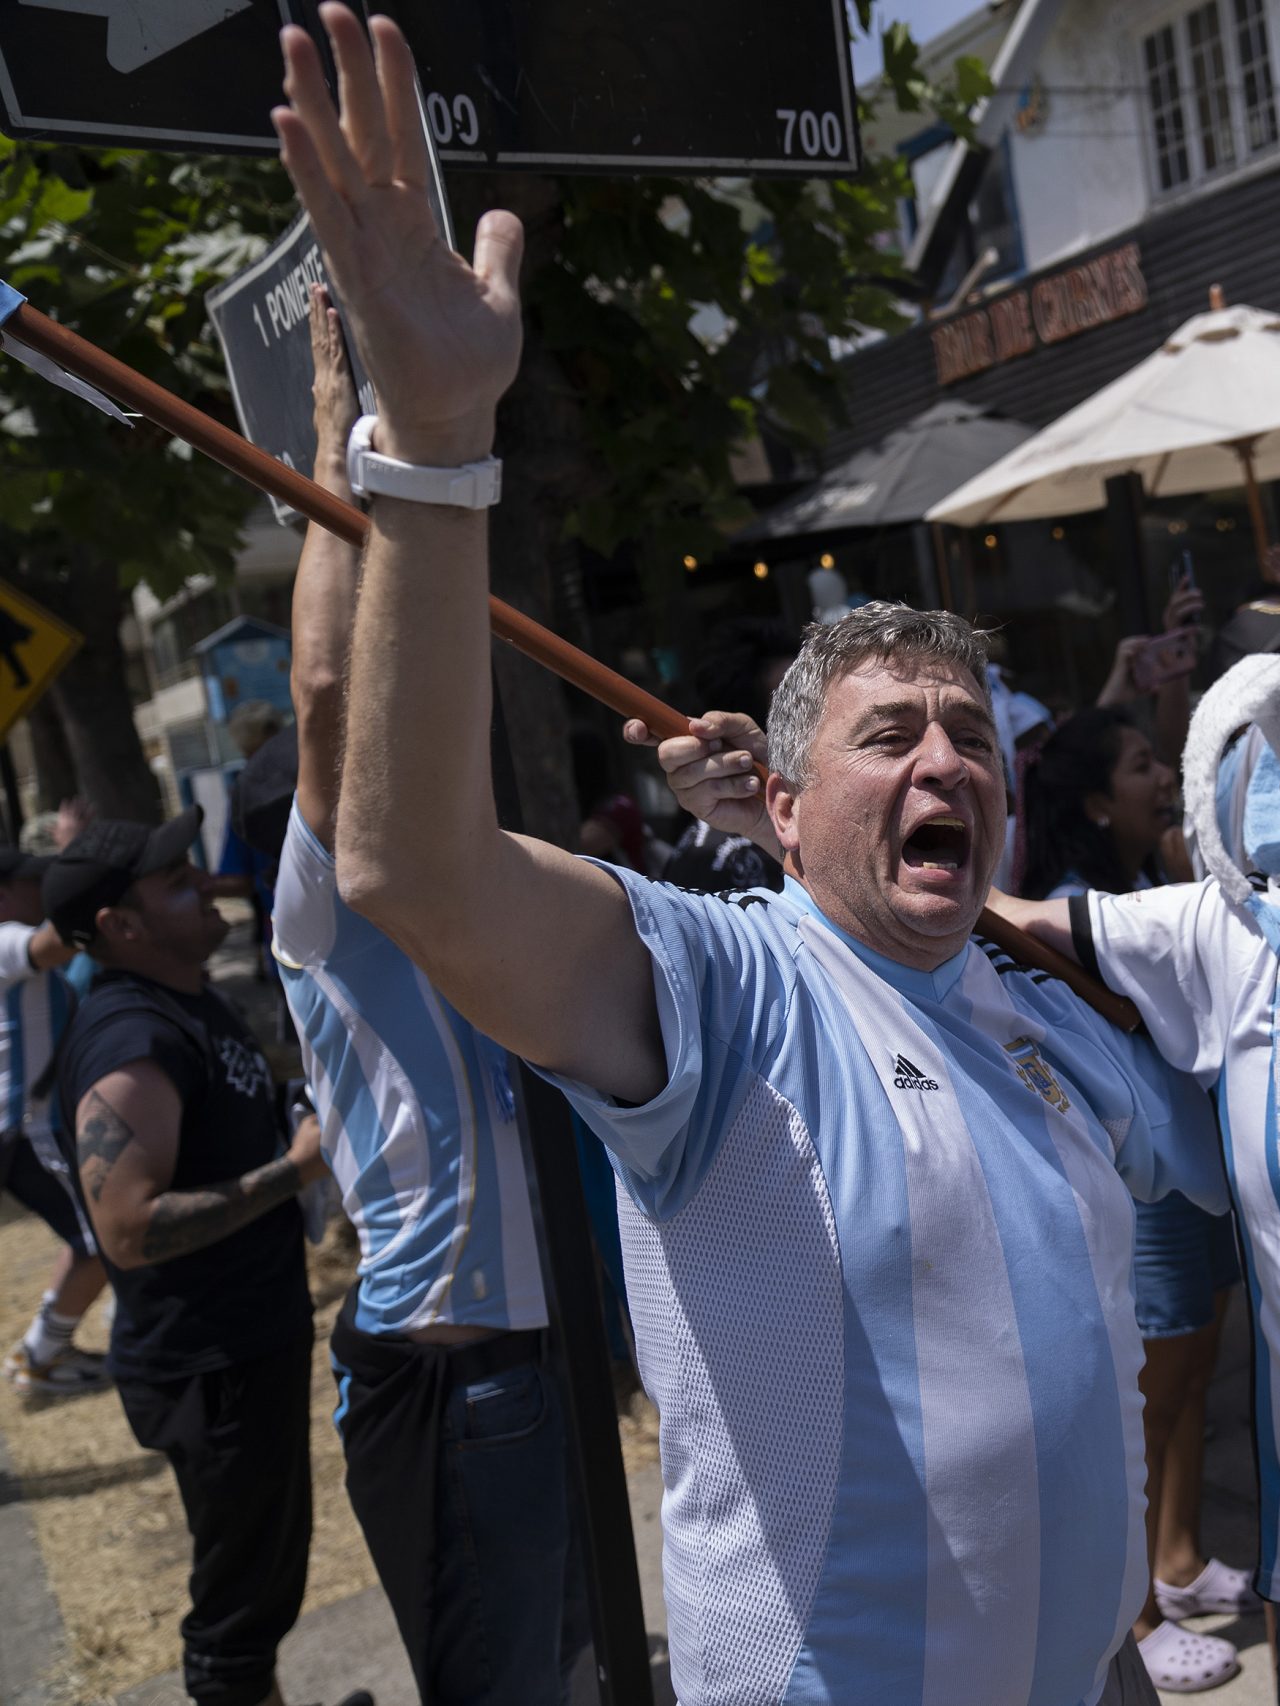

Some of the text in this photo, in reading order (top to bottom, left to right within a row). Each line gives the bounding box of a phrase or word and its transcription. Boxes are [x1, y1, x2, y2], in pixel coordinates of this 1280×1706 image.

[426, 92, 479, 145] 00
[776, 109, 842, 157] 700
[252, 303, 270, 348] 1
[894, 1075, 939, 1091] adidas
